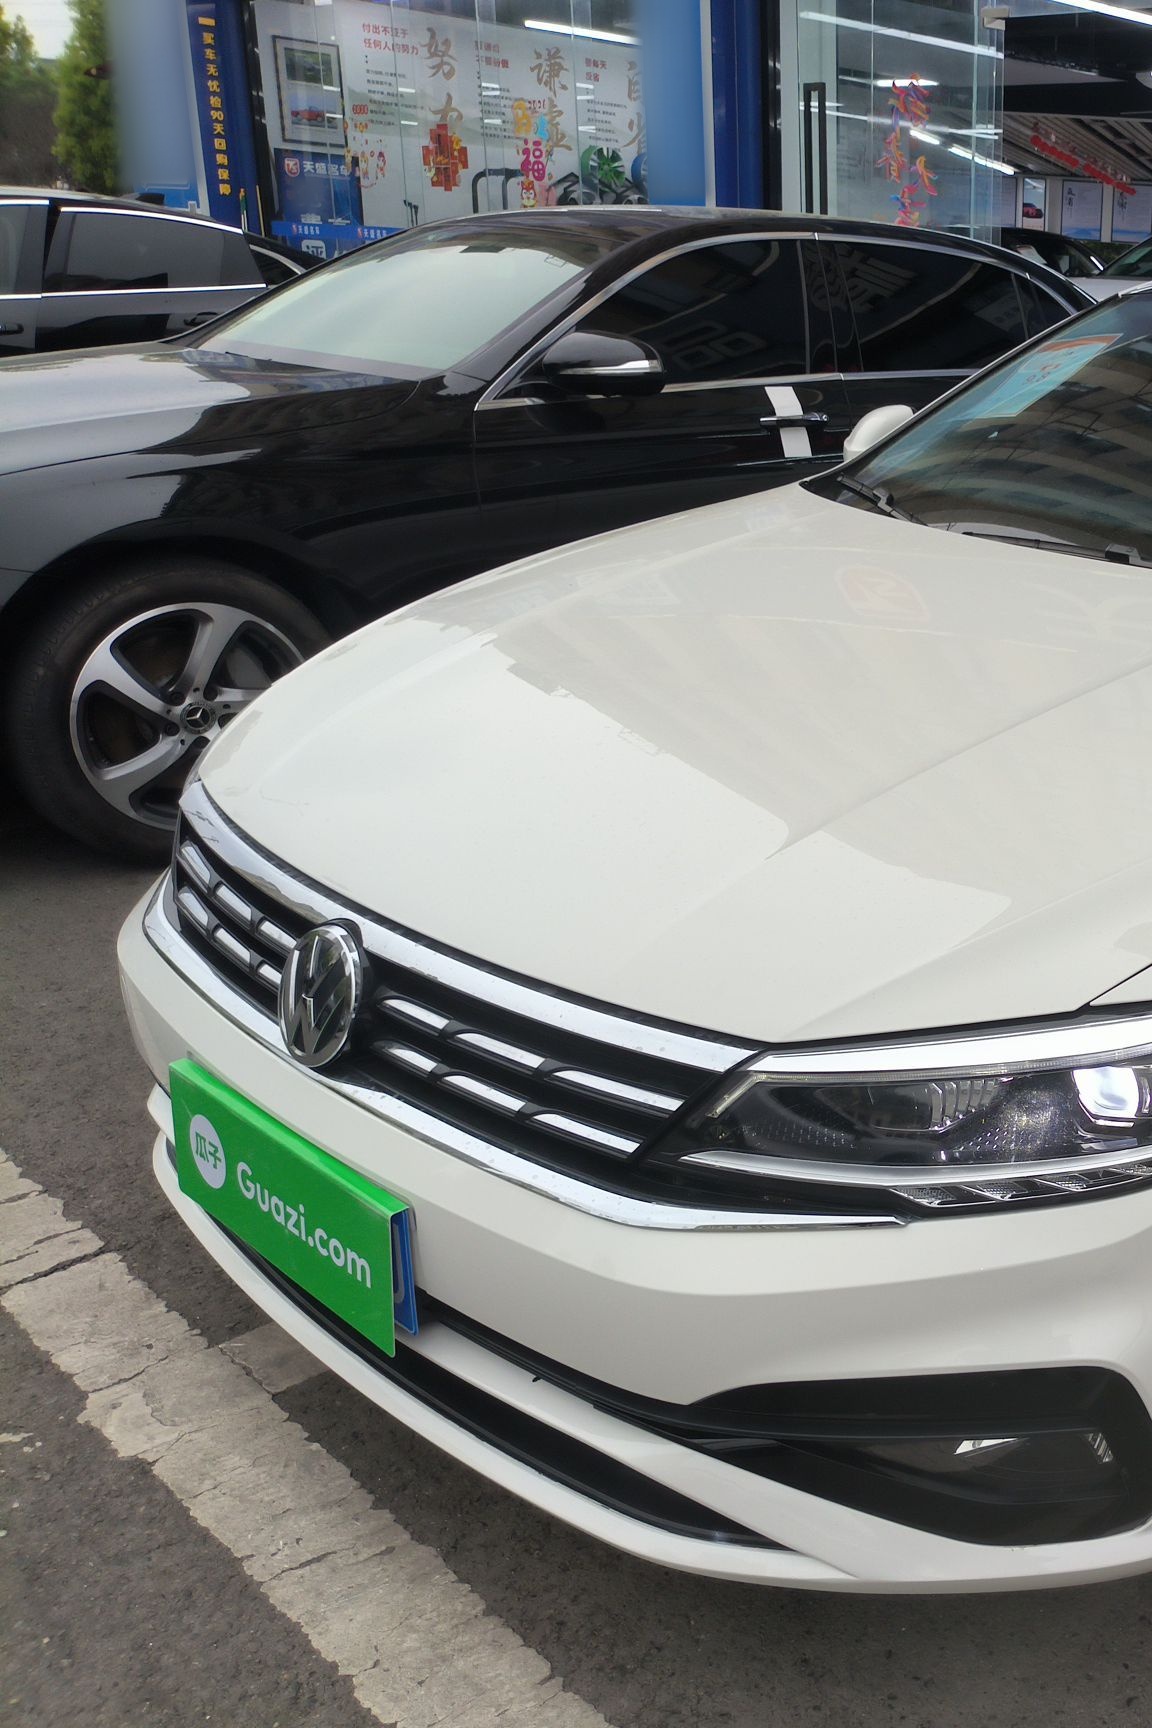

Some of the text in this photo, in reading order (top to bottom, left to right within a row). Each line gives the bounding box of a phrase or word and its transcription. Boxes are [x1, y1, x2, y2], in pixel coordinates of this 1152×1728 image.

[521, 138, 546, 181] 福
[195, 1131, 222, 1170] 瓜子
[237, 1161, 372, 1289] Guazi.com
